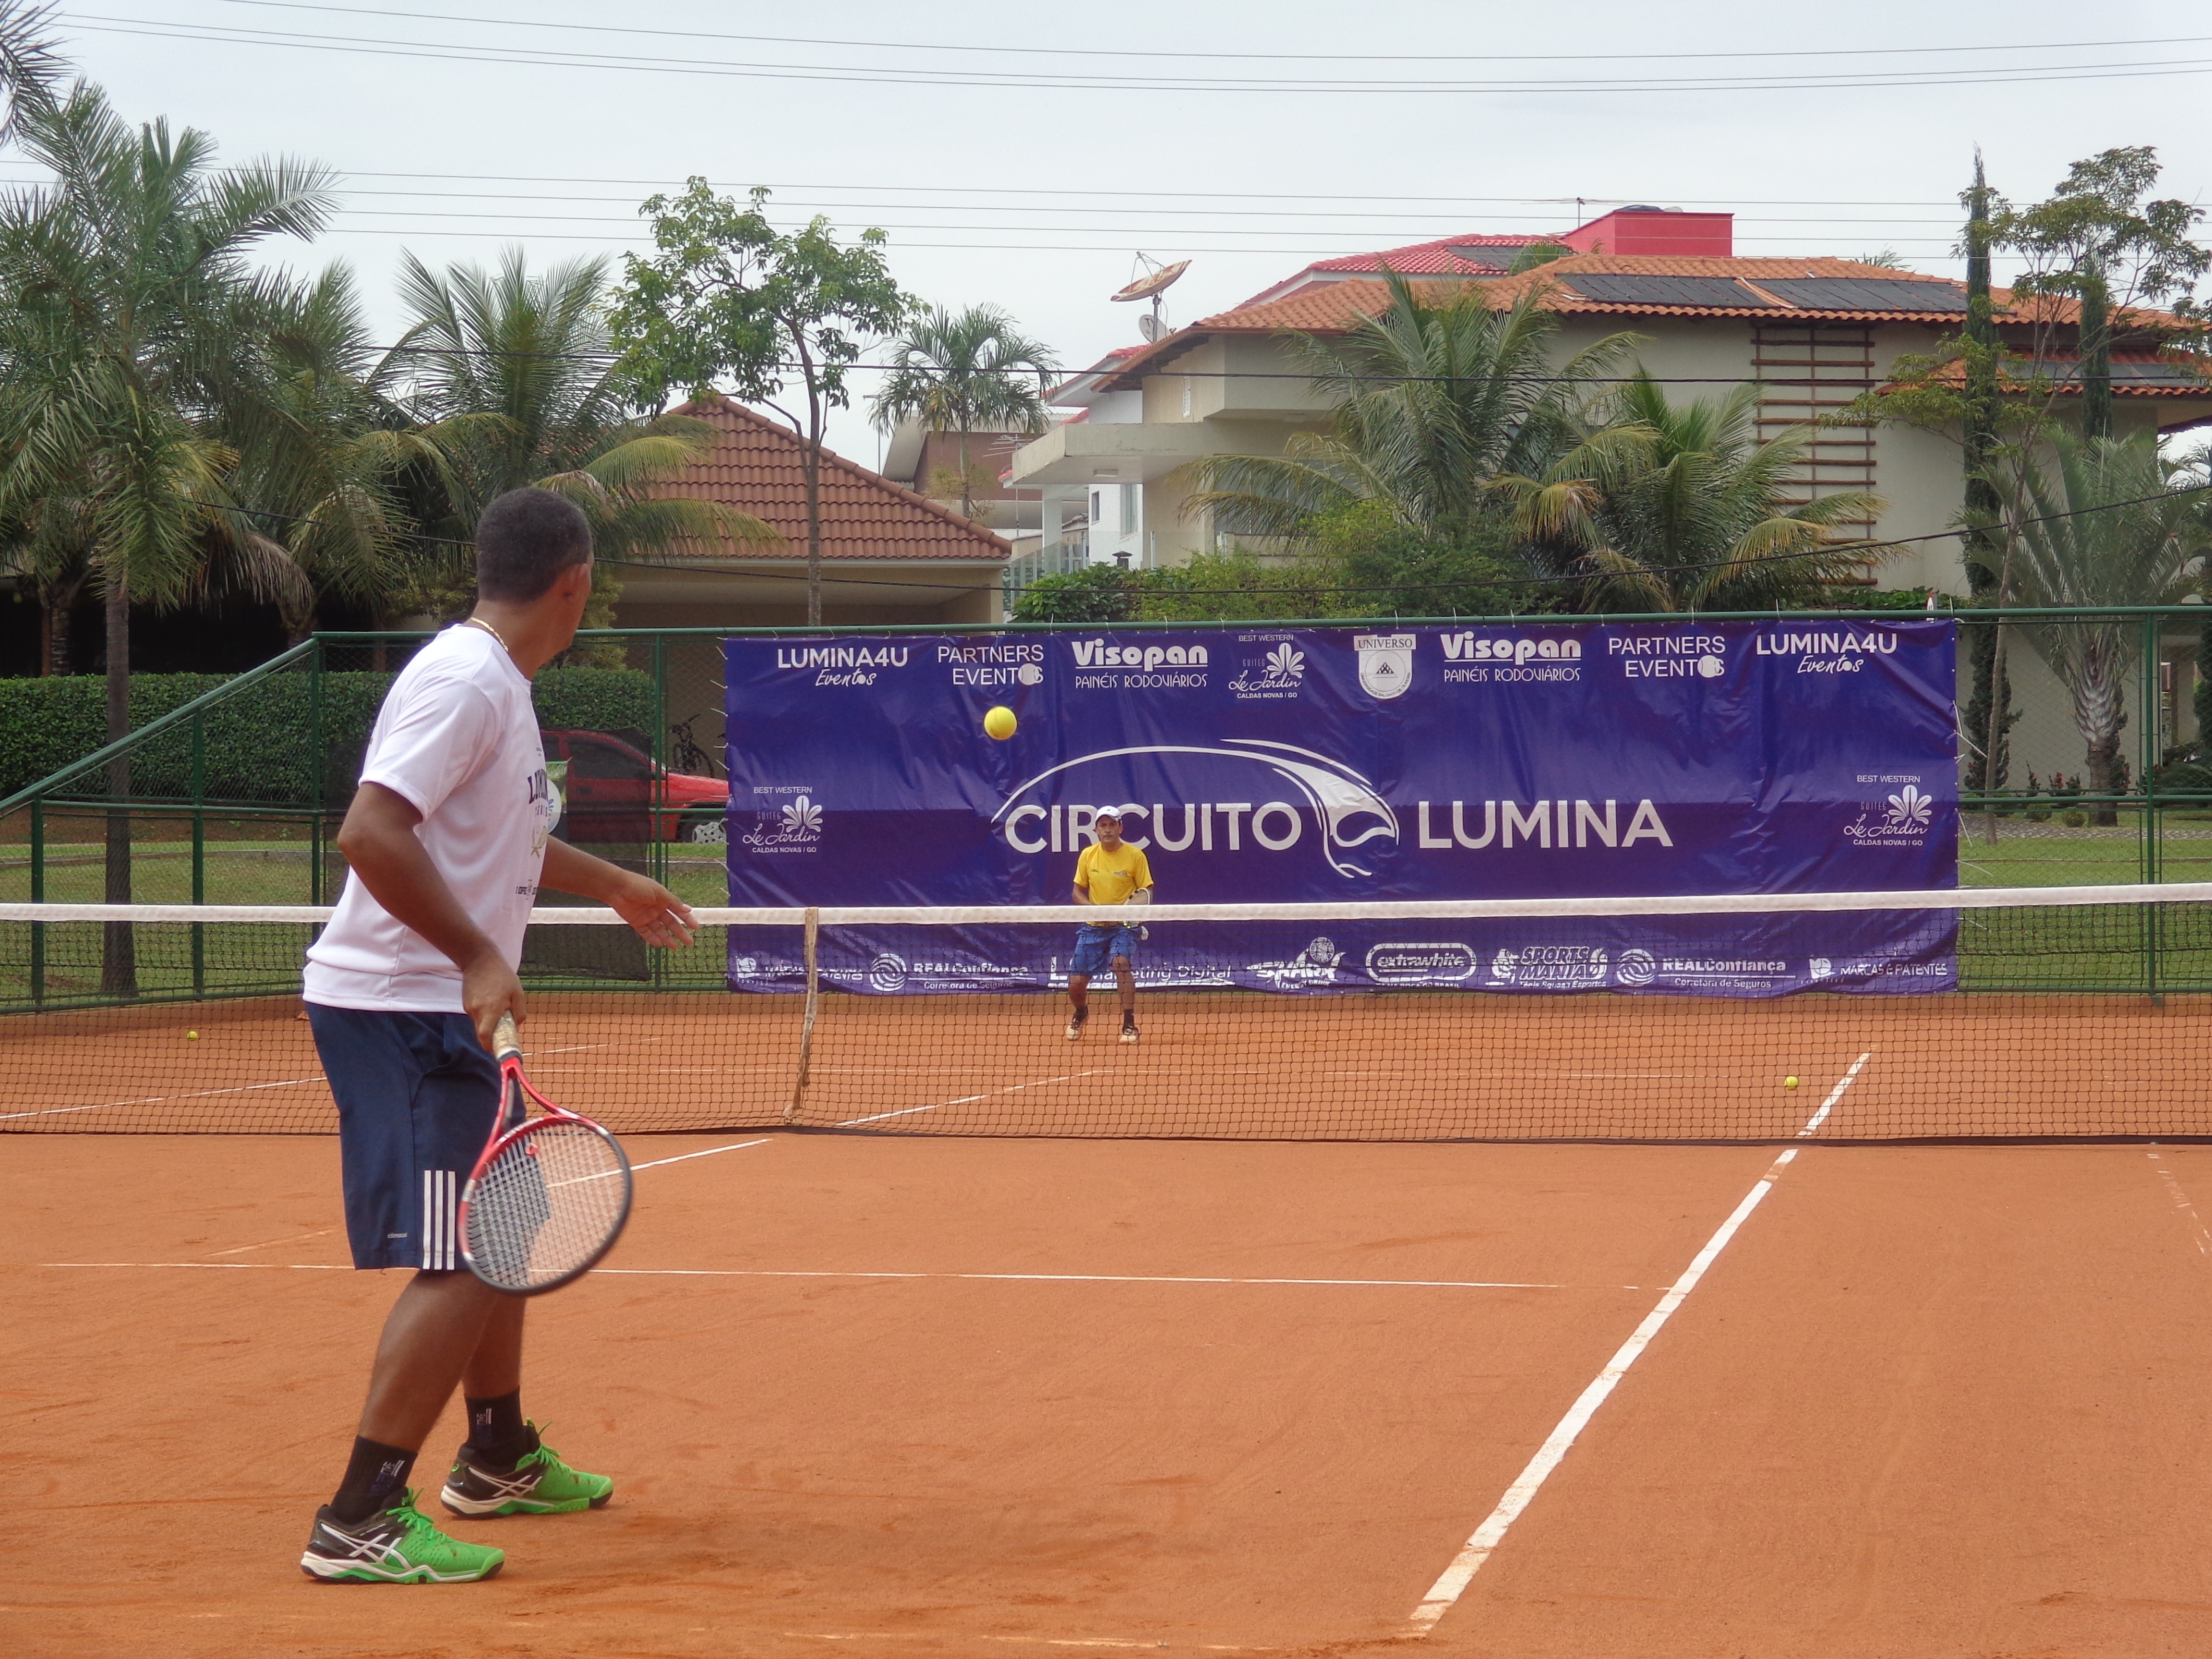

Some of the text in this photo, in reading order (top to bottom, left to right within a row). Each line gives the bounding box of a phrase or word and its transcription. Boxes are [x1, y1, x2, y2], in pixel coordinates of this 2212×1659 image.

[1358, 638, 1413, 649] UNIVERSO
[1440, 631, 1581, 665] Visopan
[1609, 636, 1726, 655] PARTNERS
[1756, 633, 1897, 654] LUMINA4U
[778, 647, 908, 668] LUMINA4U
[938, 644, 1044, 663] PARTNERS
[1071, 638, 1208, 672] Visopan
[953, 663, 1044, 685] EVENTOS
[1444, 666, 1581, 682] PAINÉIS RODOVIÁRIOS
[1625, 654, 1725, 678] EVENTOS
[1797, 655, 1864, 674] Eventos
[815, 668, 877, 686] Eventos
[1075, 671, 1208, 689] PAINÉIS RODOVIÁRIOS
[1228, 670, 1301, 691] Le Jardin
[1861, 802, 1887, 810] SUITES
[743, 823, 820, 846] Le Jardin
[1005, 799, 1673, 854] CIRCUITO LUMINA
[1844, 814, 1928, 838] Le Jardin
[1377, 953, 1465, 968] extrawhite
[1520, 946, 1590, 965] SPORTS
[1519, 964, 1587, 980] MANIA
[1840, 963, 1884, 976] MARCAS
[1895, 963, 1948, 976] PATENTES
[1719, 978, 1731, 987] de
[1734, 979, 1771, 989] Seguros
